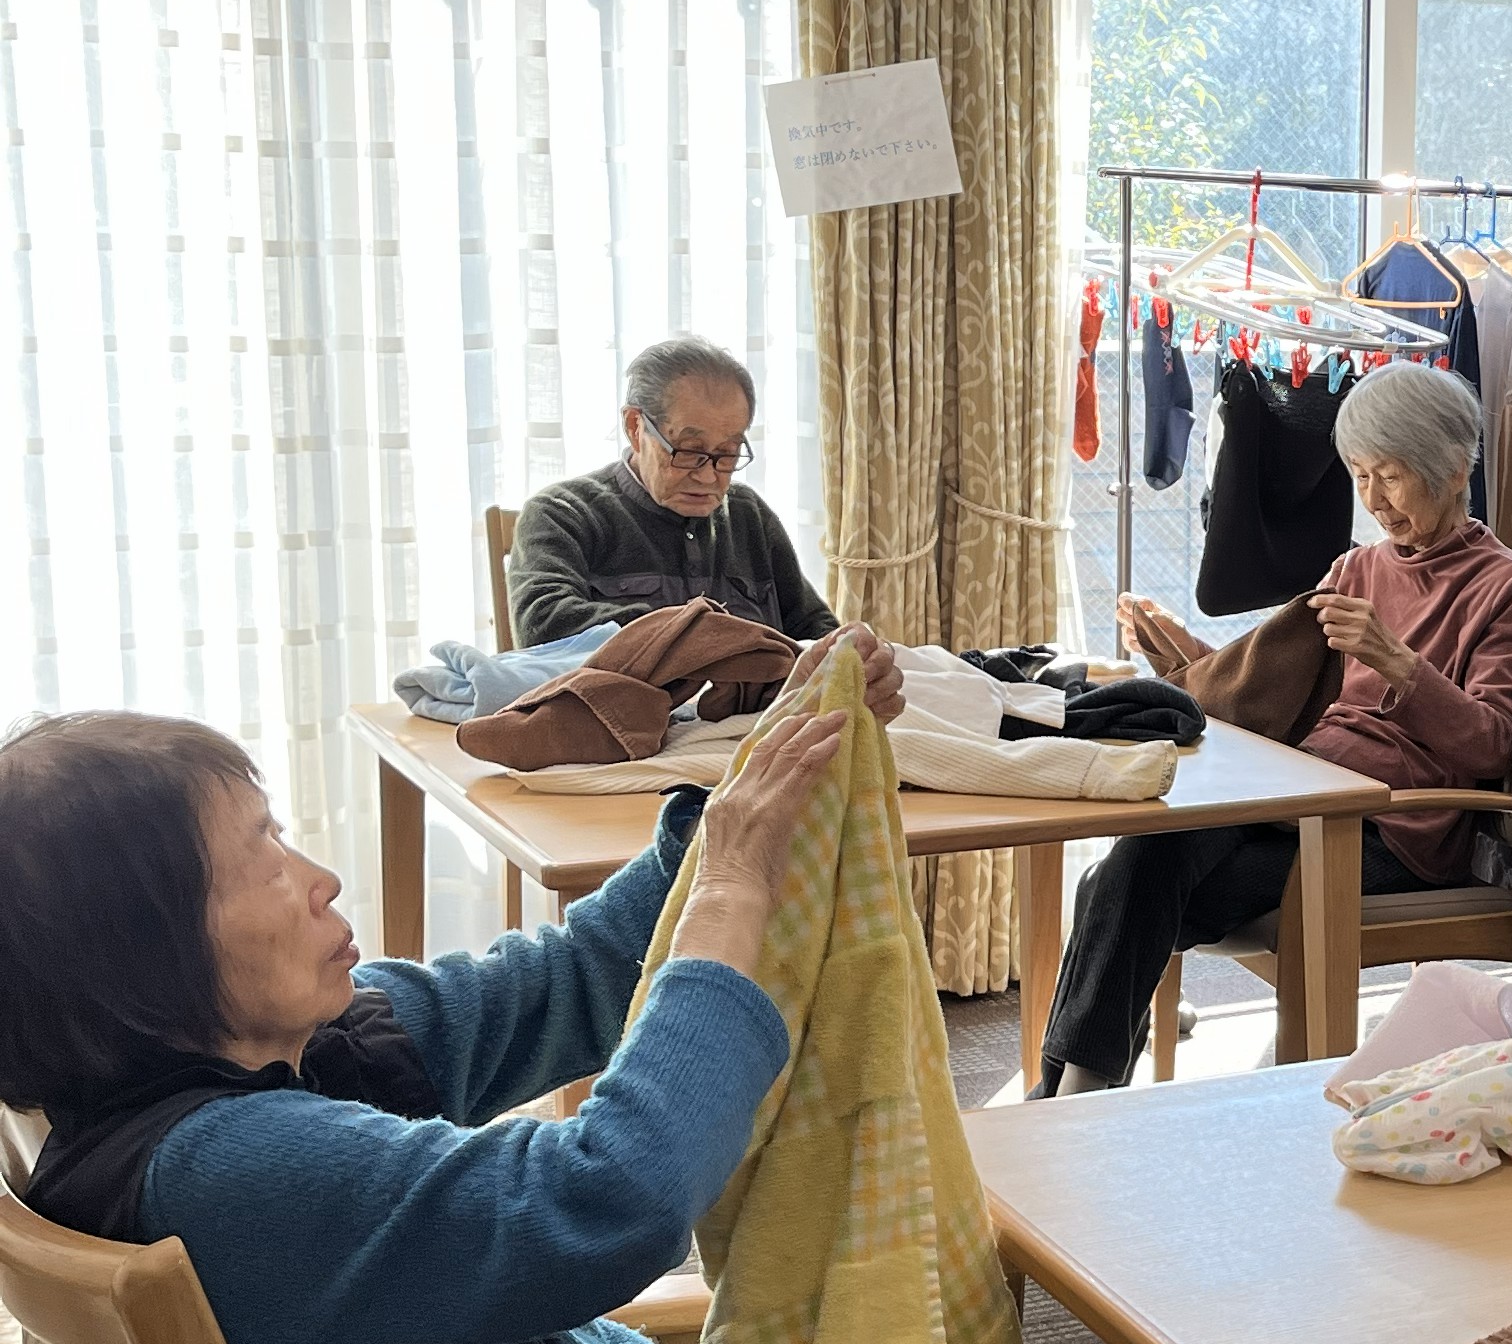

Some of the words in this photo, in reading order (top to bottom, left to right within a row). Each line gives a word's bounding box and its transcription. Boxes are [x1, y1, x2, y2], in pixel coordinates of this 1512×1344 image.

[788, 119, 862, 141] 換気中です。
[794, 139, 938, 169] 窓は閉めないで下さい。
